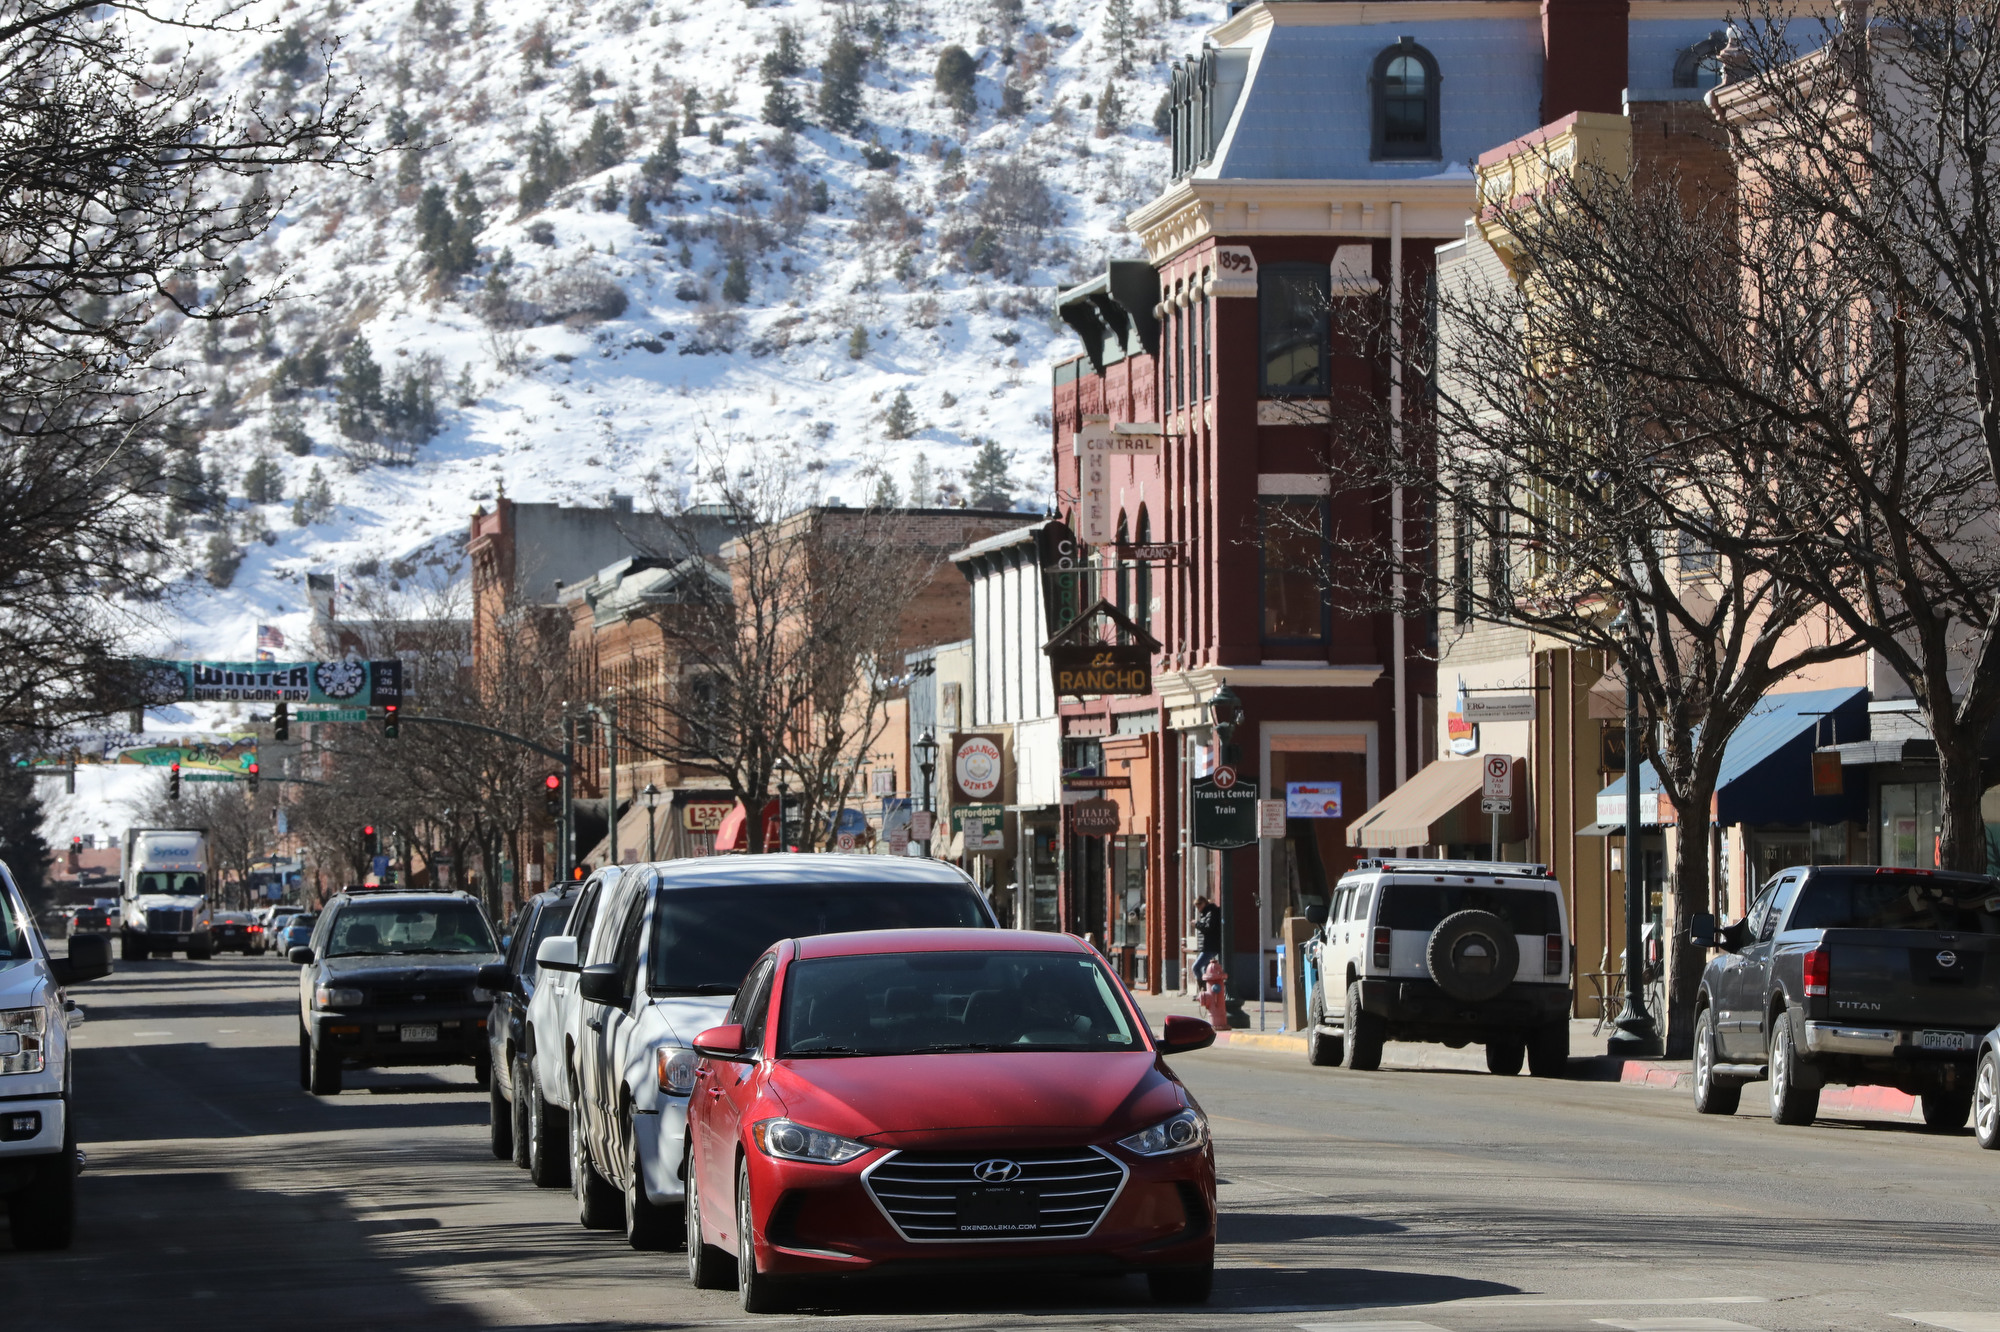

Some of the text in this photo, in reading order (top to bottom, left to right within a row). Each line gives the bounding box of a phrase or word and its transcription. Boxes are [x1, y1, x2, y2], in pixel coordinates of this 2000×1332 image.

[1218, 251, 1253, 273] 1892
[1087, 439, 1154, 450] CENTRAL
[1090, 454, 1103, 537] HOTEL
[1135, 548, 1172, 558] VACANCY
[193, 663, 309, 687] WINTER
[1060, 669, 1146, 690] RANCHO
[284, 689, 309, 701] DAY
[376, 687, 398, 696] 2021
[1466, 702, 1485, 711] ERO
[302, 711, 360, 721] 9TH STREET
[958, 744, 999, 760] DURANGO
[963, 779, 994, 790] DINER
[1195, 790, 1255, 798] Transit Center
[954, 807, 1002, 819] Affordable
[1081, 808, 1111, 817] HAIR
[1215, 805, 1237, 814] Train
[1077, 817, 1116, 826] FUSION
[153, 847, 190, 857] Sysco
[1764, 849, 1778, 859] 1021
[1836, 1001, 1881, 1010] TITAN
